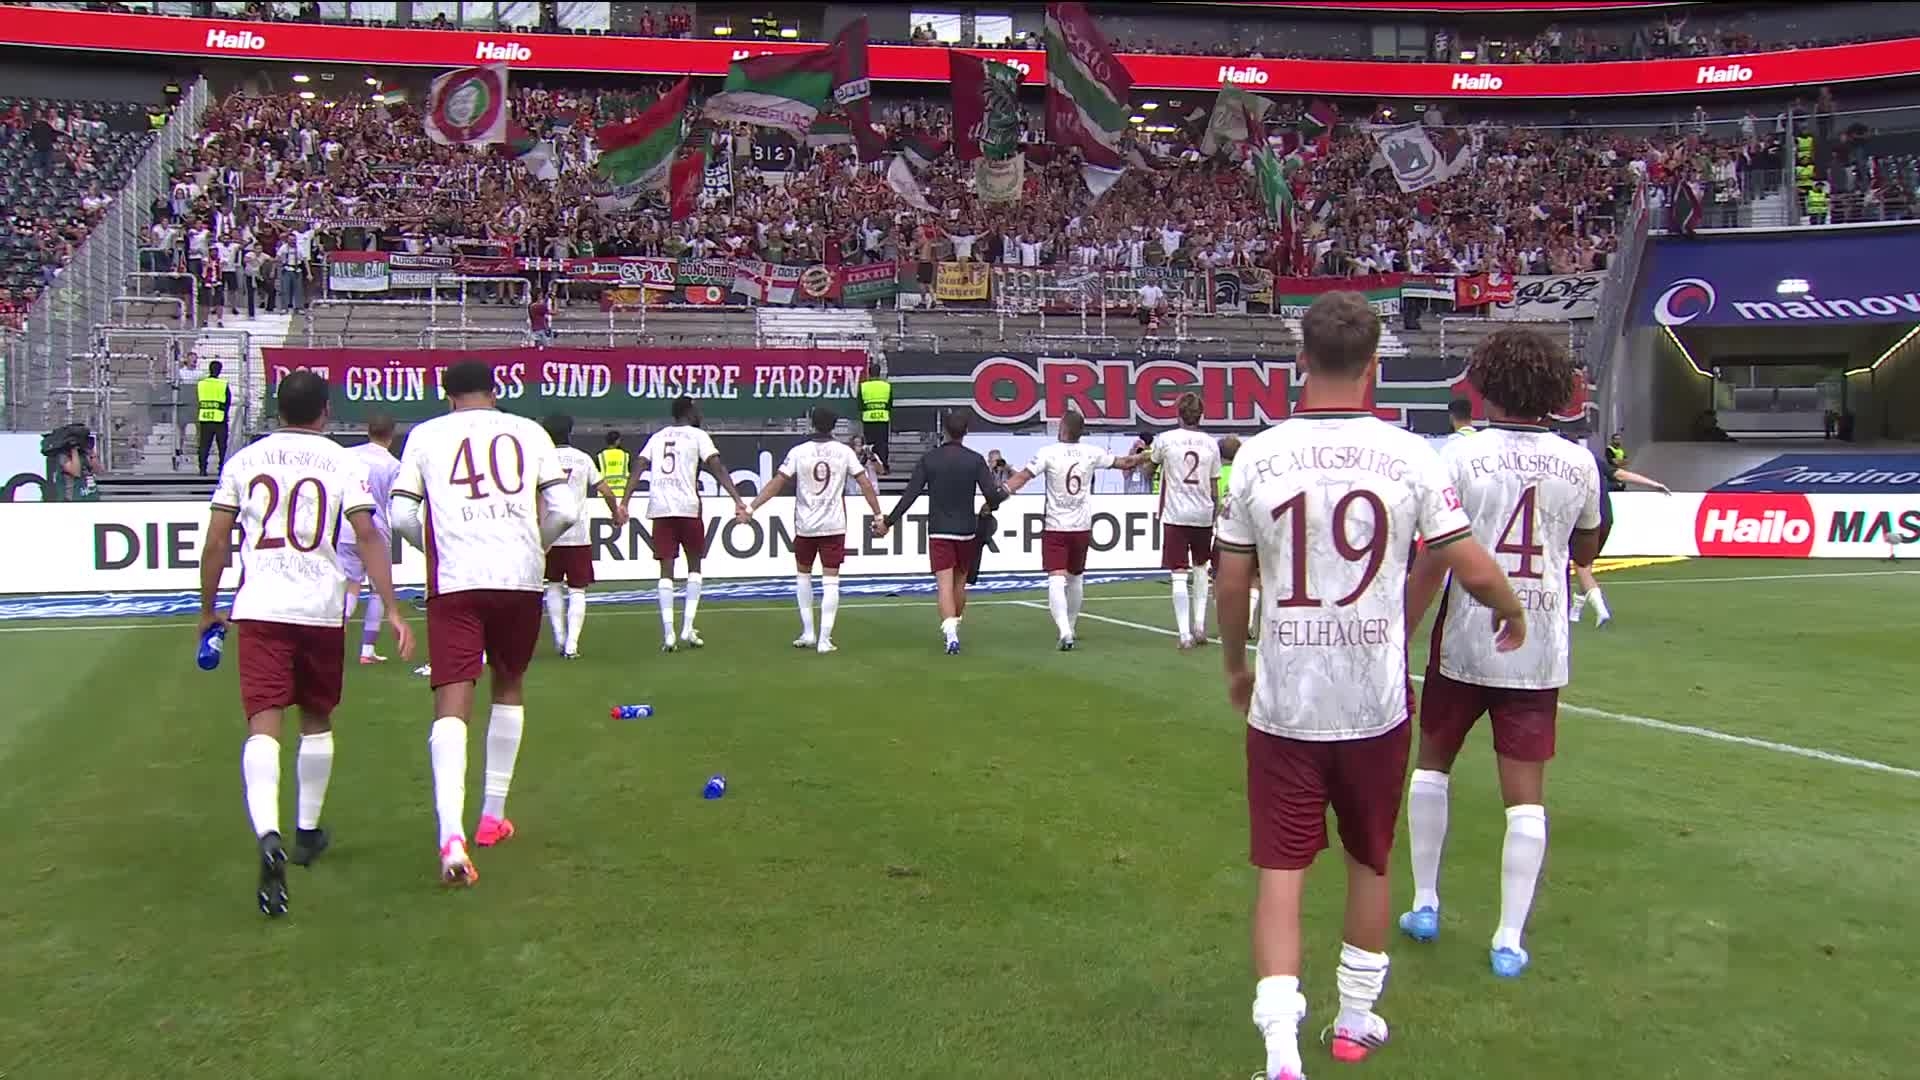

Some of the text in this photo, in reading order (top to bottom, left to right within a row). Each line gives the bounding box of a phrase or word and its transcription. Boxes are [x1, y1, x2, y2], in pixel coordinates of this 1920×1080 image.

[206, 29, 265, 50] Hailo
[475, 40, 532, 62] Hailo
[1217, 66, 1269, 86] Hailo
[1451, 73, 1503, 91] Hailo
[1696, 64, 1753, 85] Hailo
[346, 360, 426, 401] GRÜN
[541, 361, 612, 398] SIND
[626, 363, 740, 399] UNSERE
[753, 365, 863, 399] FARBEN
[449, 432, 525, 500] 40
[661, 441, 676, 475] 5
[1184, 451, 1200, 485] 2
[1255, 446, 1409, 484] FC AUGSBURG
[1470, 451, 1583, 485] FC AUGSBURG
[813, 461, 831, 496] 9
[1065, 462, 1081, 496] 6
[248, 472, 328, 553] 20
[1702, 508, 1811, 544] Hailo
[94, 522, 200, 570] DIE
[1271, 489, 1389, 608] 19
[1495, 485, 1544, 579] 4
[1271, 618, 1390, 647] FELLHAUER
